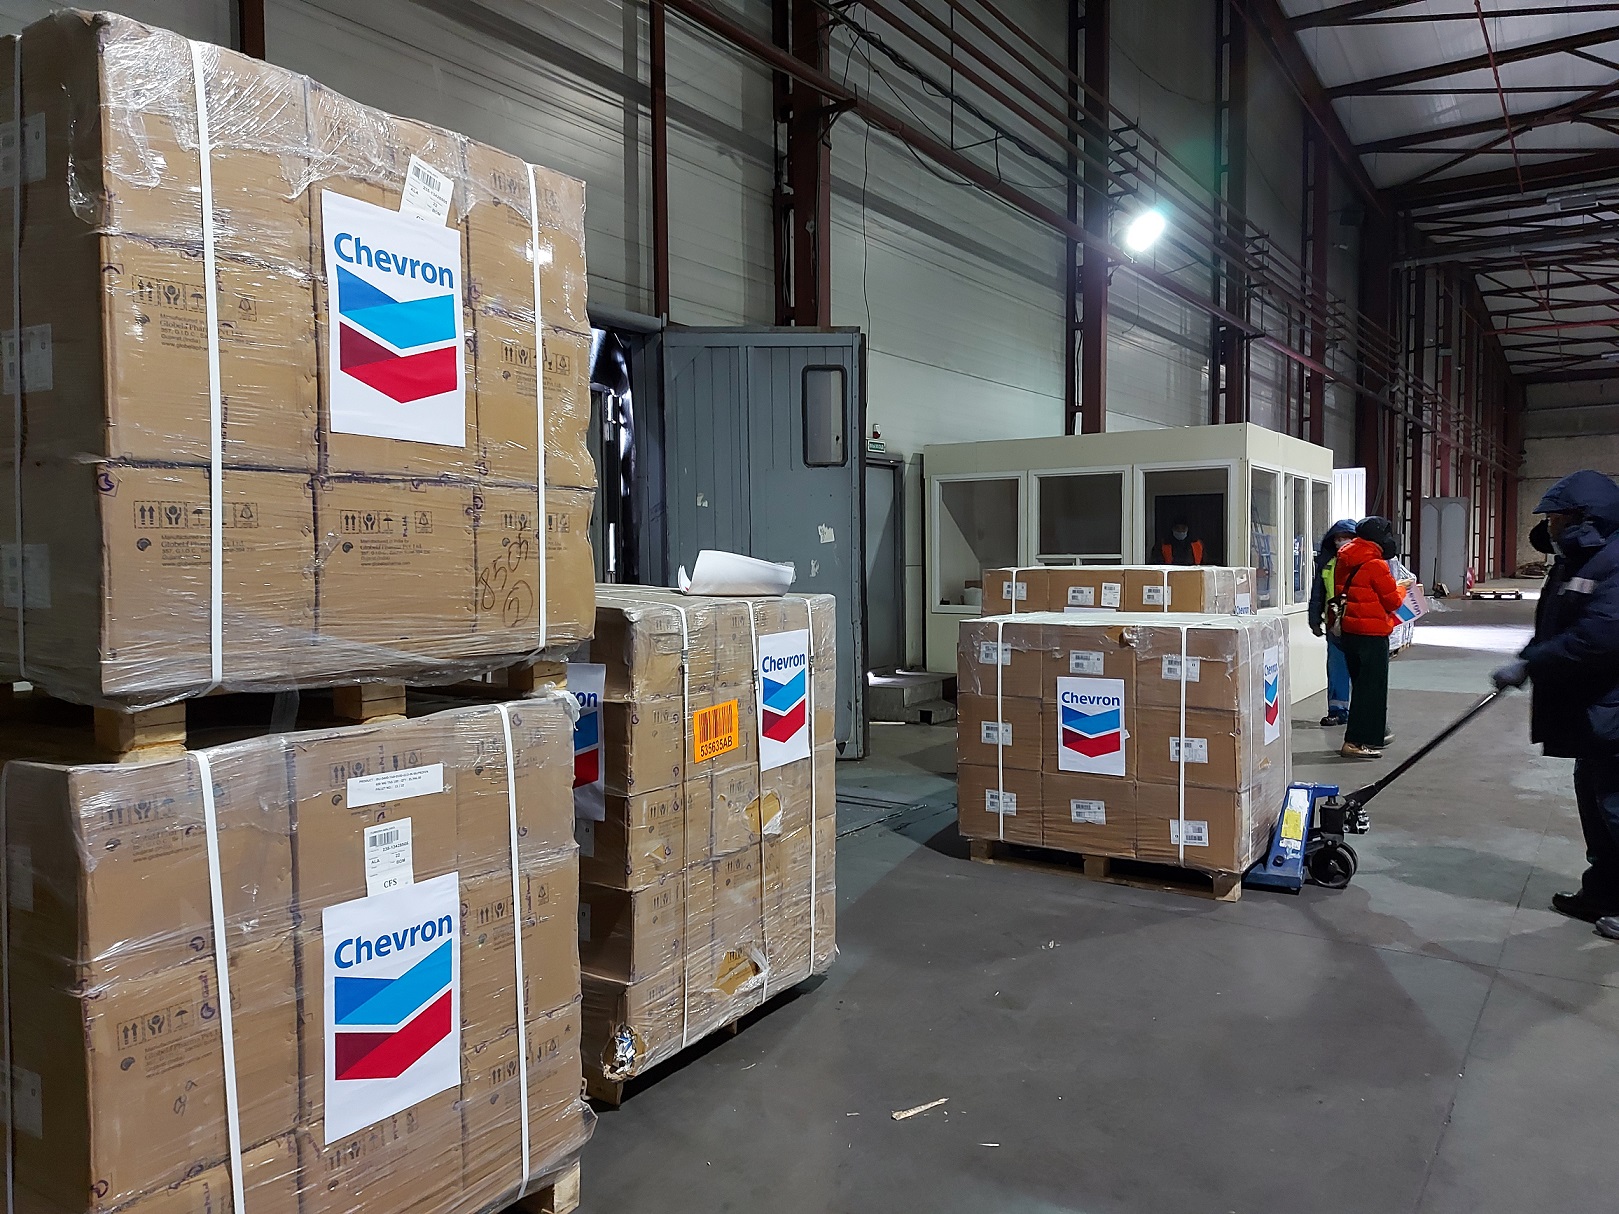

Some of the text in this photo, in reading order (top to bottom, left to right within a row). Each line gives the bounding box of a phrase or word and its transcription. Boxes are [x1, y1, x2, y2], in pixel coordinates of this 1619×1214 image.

[334, 232, 454, 289] Chevron
[762, 653, 806, 673] Chevron
[1264, 662, 1278, 677] Chevron
[1061, 691, 1120, 706] Chevron
[700, 735, 733, 758] 535635AB
[383, 878, 398, 888] CFS
[334, 914, 453, 969] Chevron
